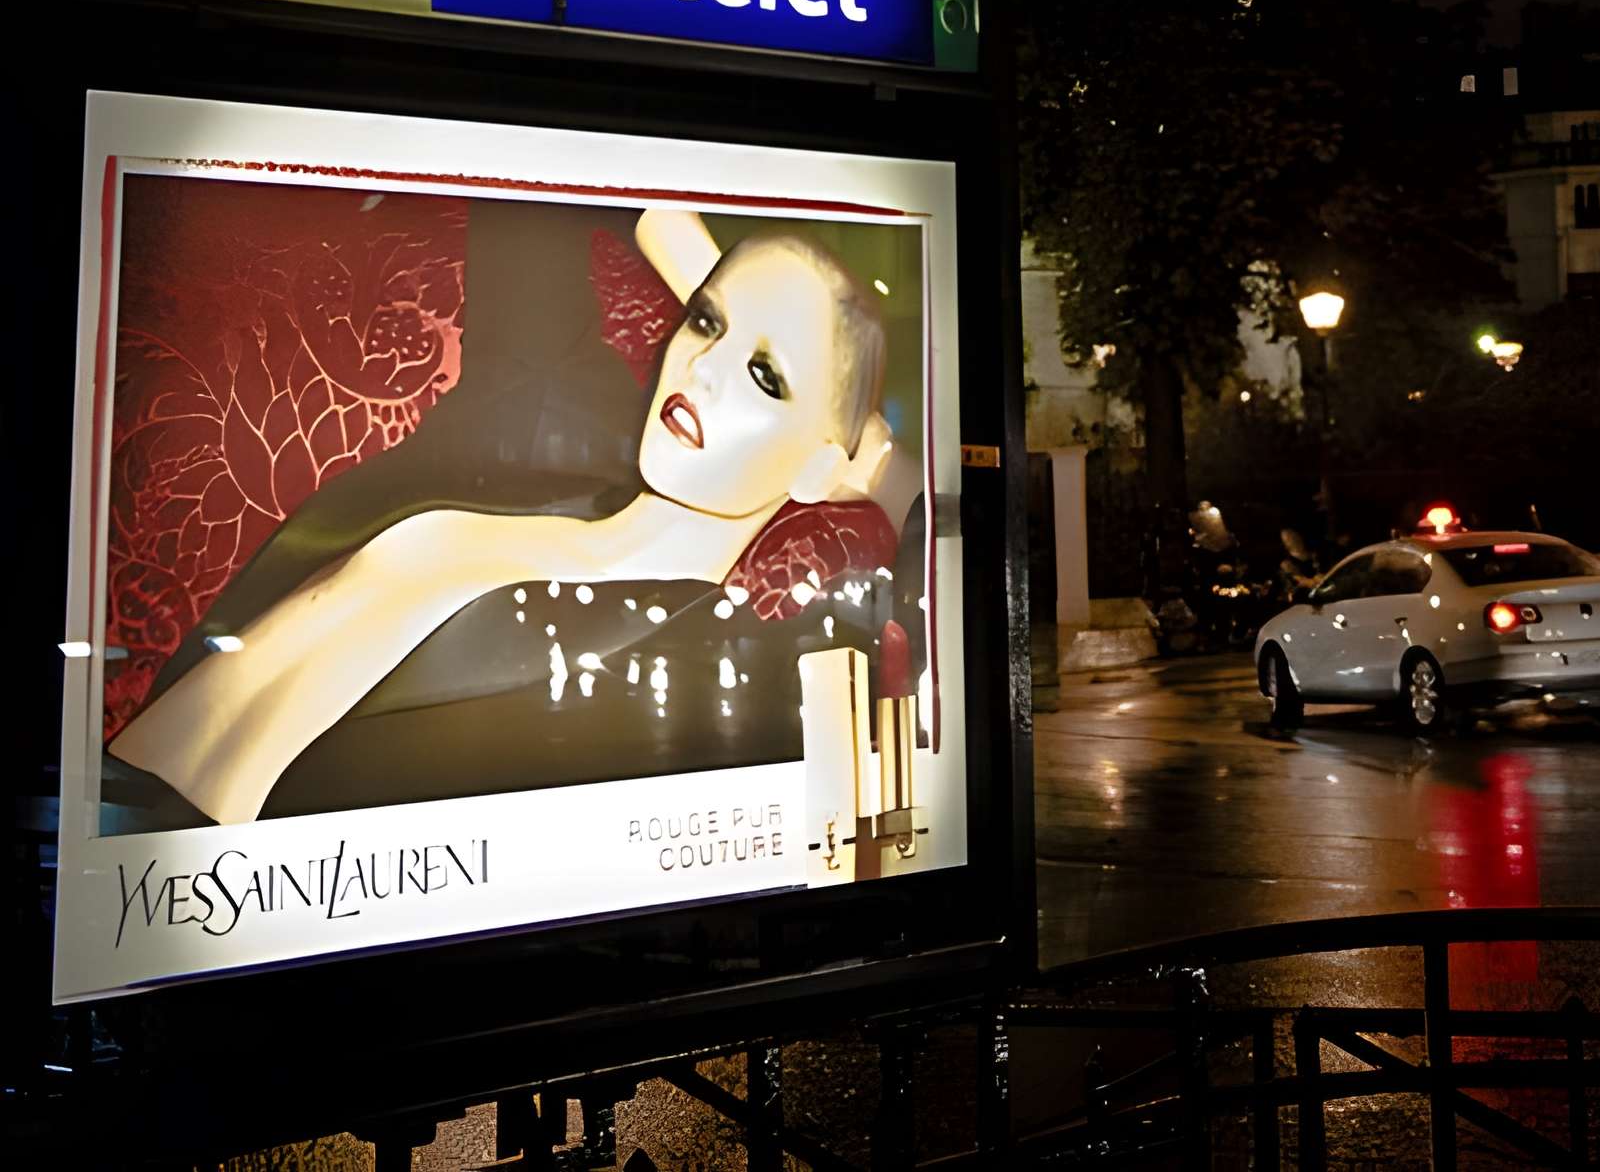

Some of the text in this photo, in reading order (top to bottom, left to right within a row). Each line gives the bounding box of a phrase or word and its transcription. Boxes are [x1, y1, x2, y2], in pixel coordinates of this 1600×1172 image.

[628, 803, 783, 842] ROUGE PUR
[658, 832, 784, 872] COUTURE
